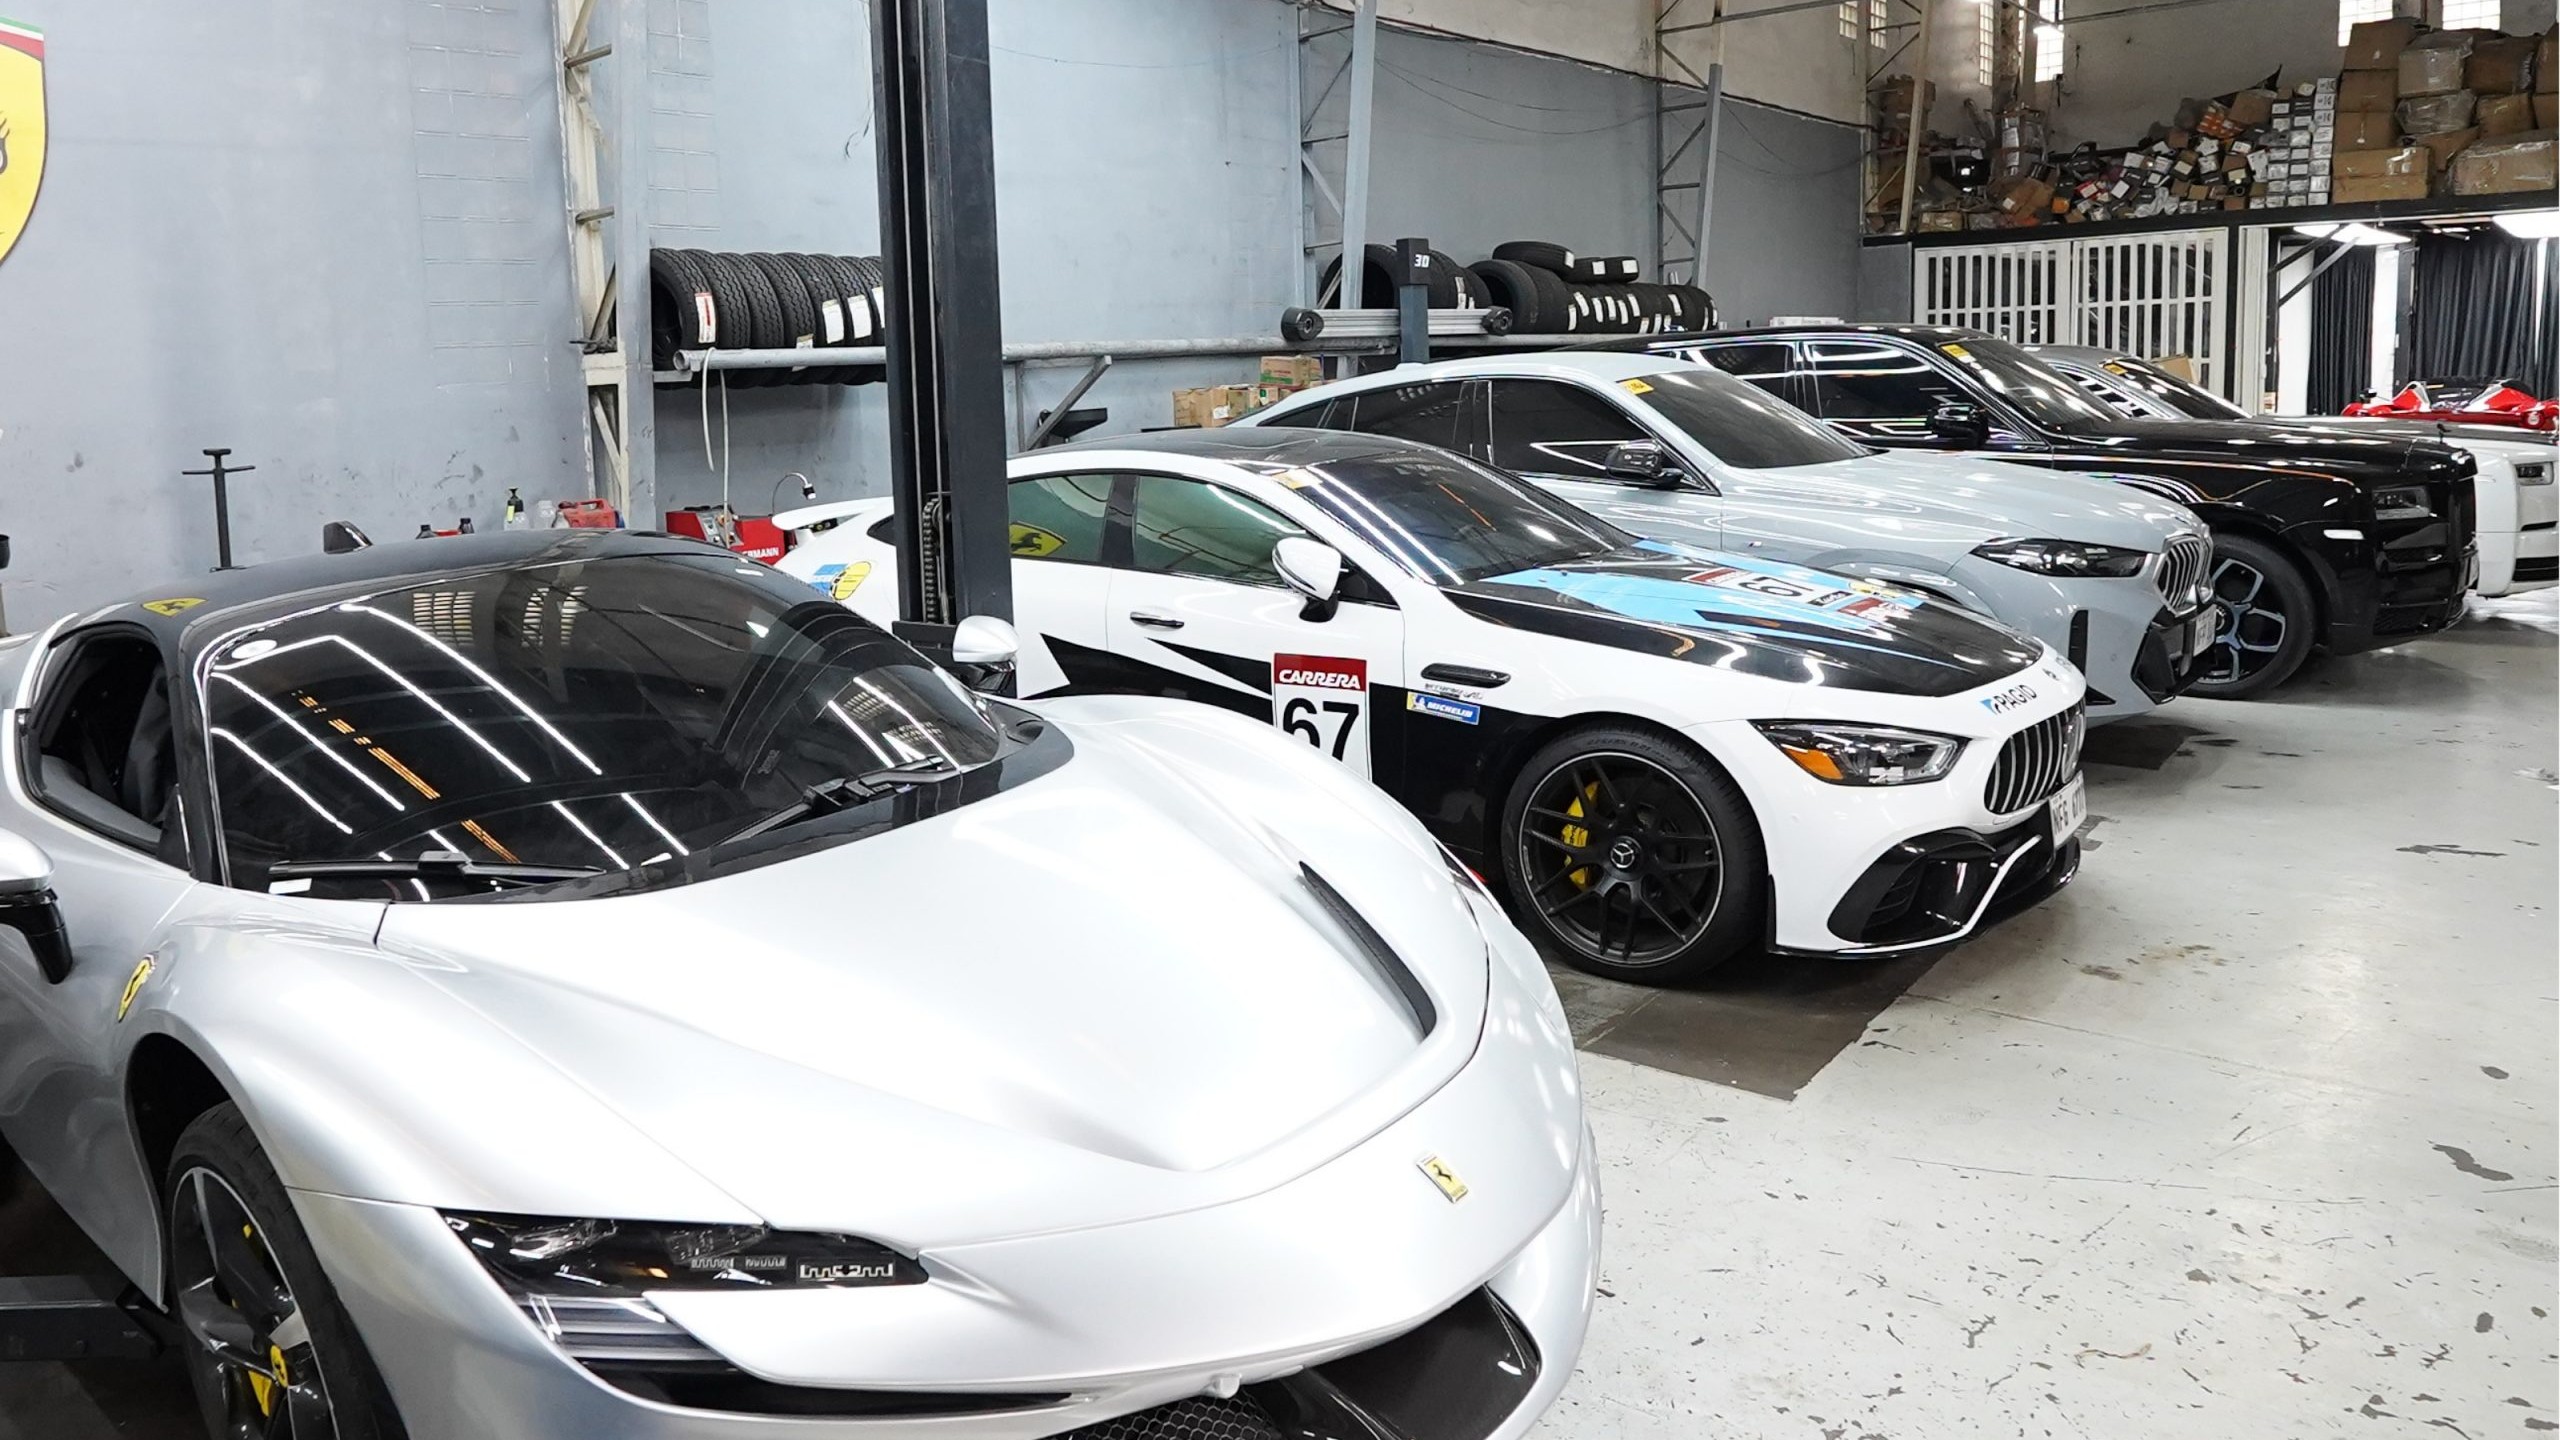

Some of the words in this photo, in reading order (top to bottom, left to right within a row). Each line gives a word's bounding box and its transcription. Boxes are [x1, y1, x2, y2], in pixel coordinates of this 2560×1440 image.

[1278, 668, 1362, 690] CARRERA
[1426, 701, 1474, 718] MICHELIN
[1993, 684, 2038, 714] PAGID
[1282, 697, 1360, 763] 67
